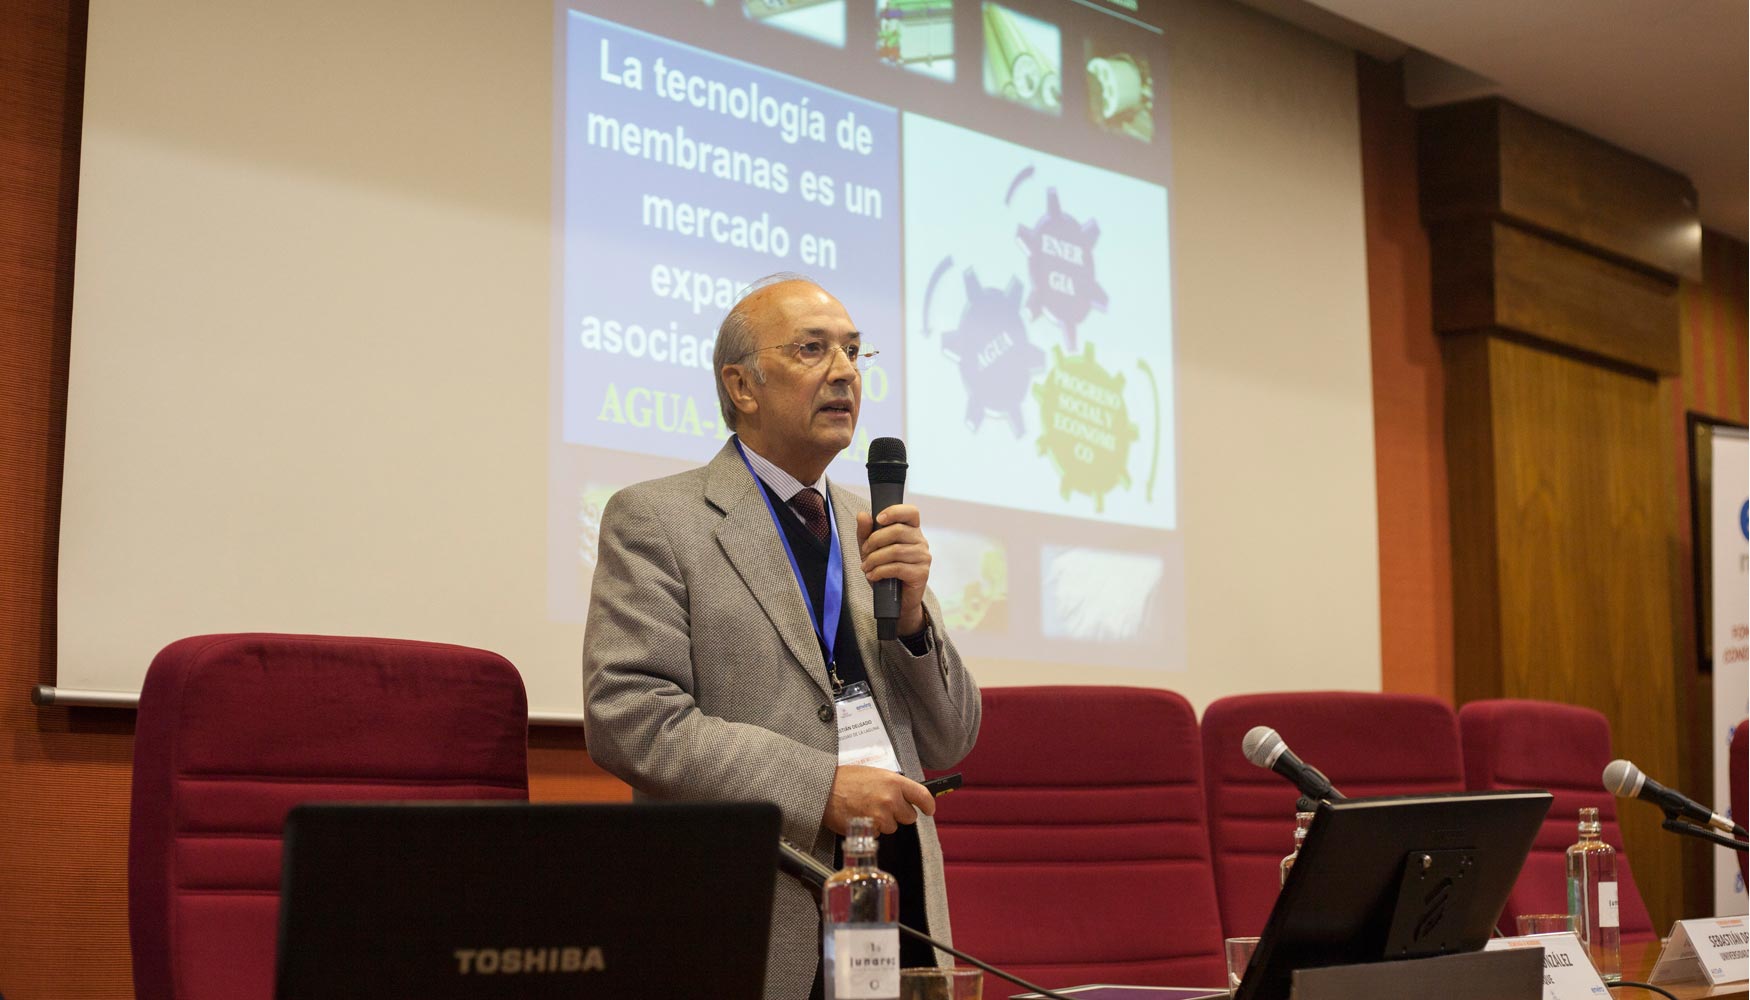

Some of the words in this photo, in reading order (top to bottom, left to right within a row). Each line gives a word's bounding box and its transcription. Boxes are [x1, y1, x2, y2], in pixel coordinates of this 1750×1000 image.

[600, 38, 643, 91] La
[653, 56, 826, 144] tecnología
[837, 112, 873, 155] de
[587, 112, 789, 194] membranas
[800, 170, 835, 206] es
[846, 182, 882, 219] un
[642, 193, 789, 257] mercado
[800, 231, 837, 270] en
[1041, 234, 1083, 265] ENER
[977, 331, 1013, 371] AGUA
[1709, 931, 1743, 947] SEBASTIÁN
[453, 947, 605, 975] TOSHIBA
